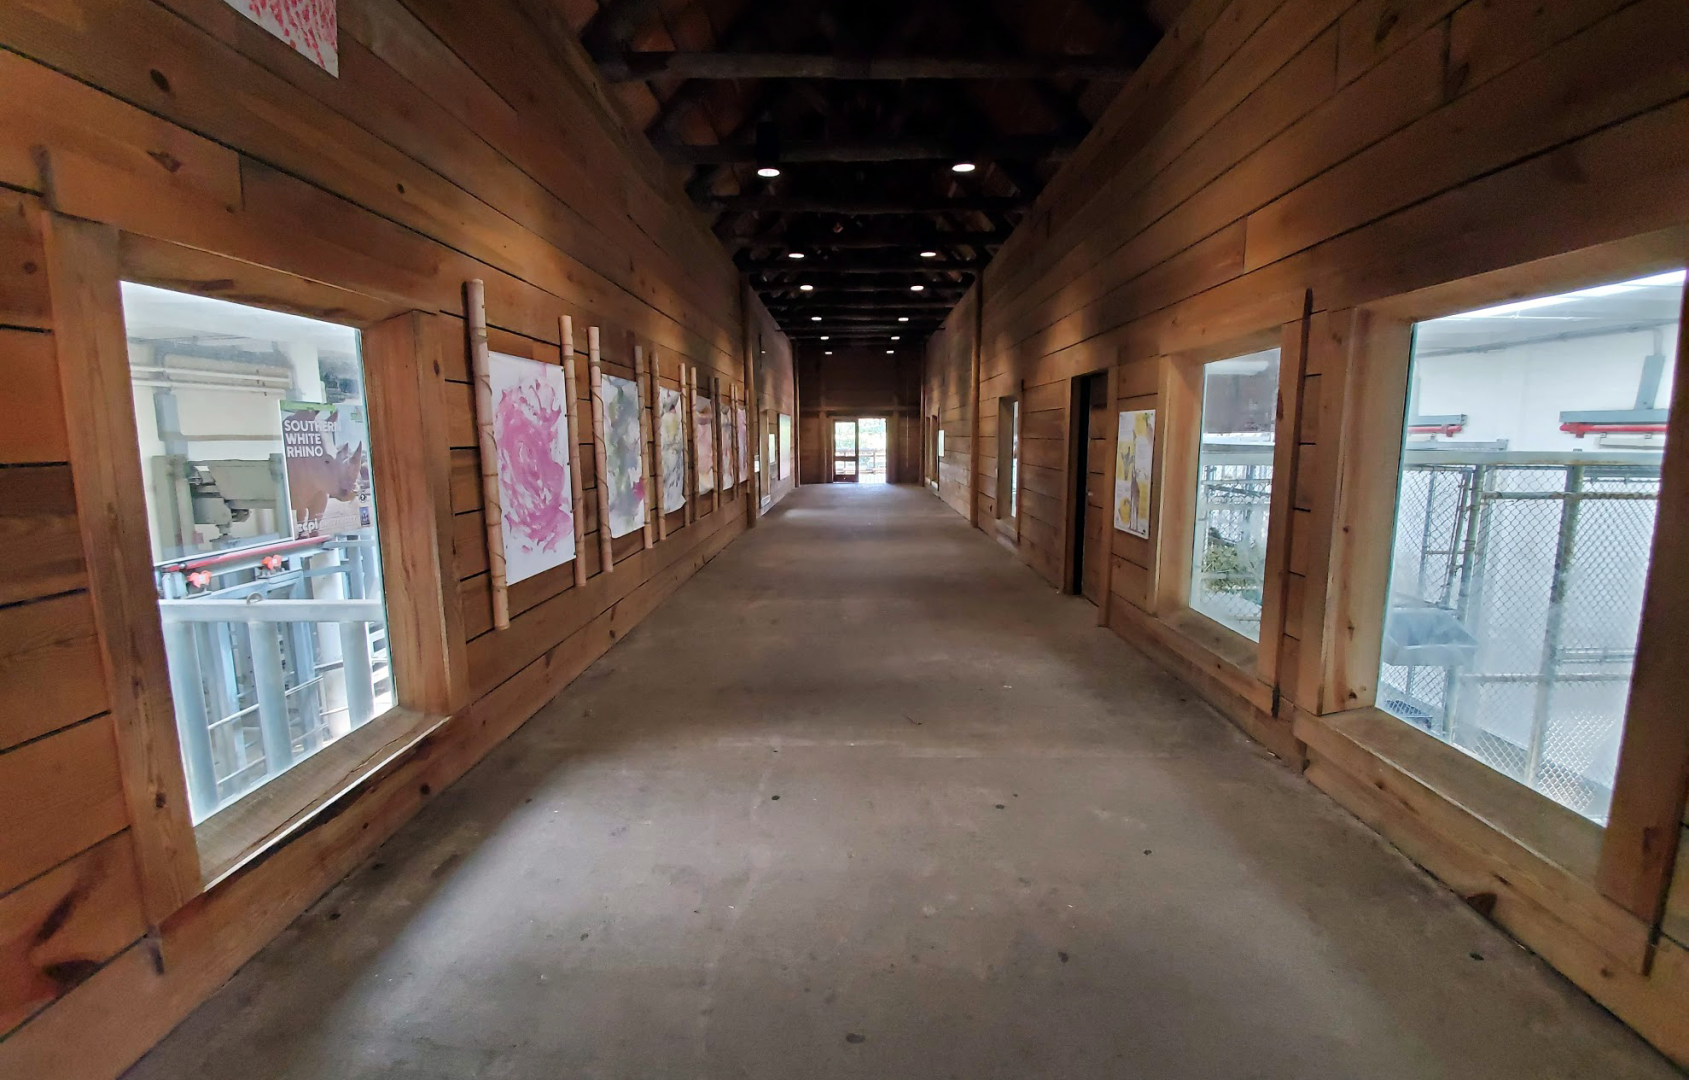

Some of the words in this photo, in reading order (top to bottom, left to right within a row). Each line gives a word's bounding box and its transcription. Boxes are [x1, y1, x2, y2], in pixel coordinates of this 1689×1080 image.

[284, 420, 342, 432] SOUTHERN
[285, 433, 322, 445] WHITE
[286, 445, 324, 458] RHINO
